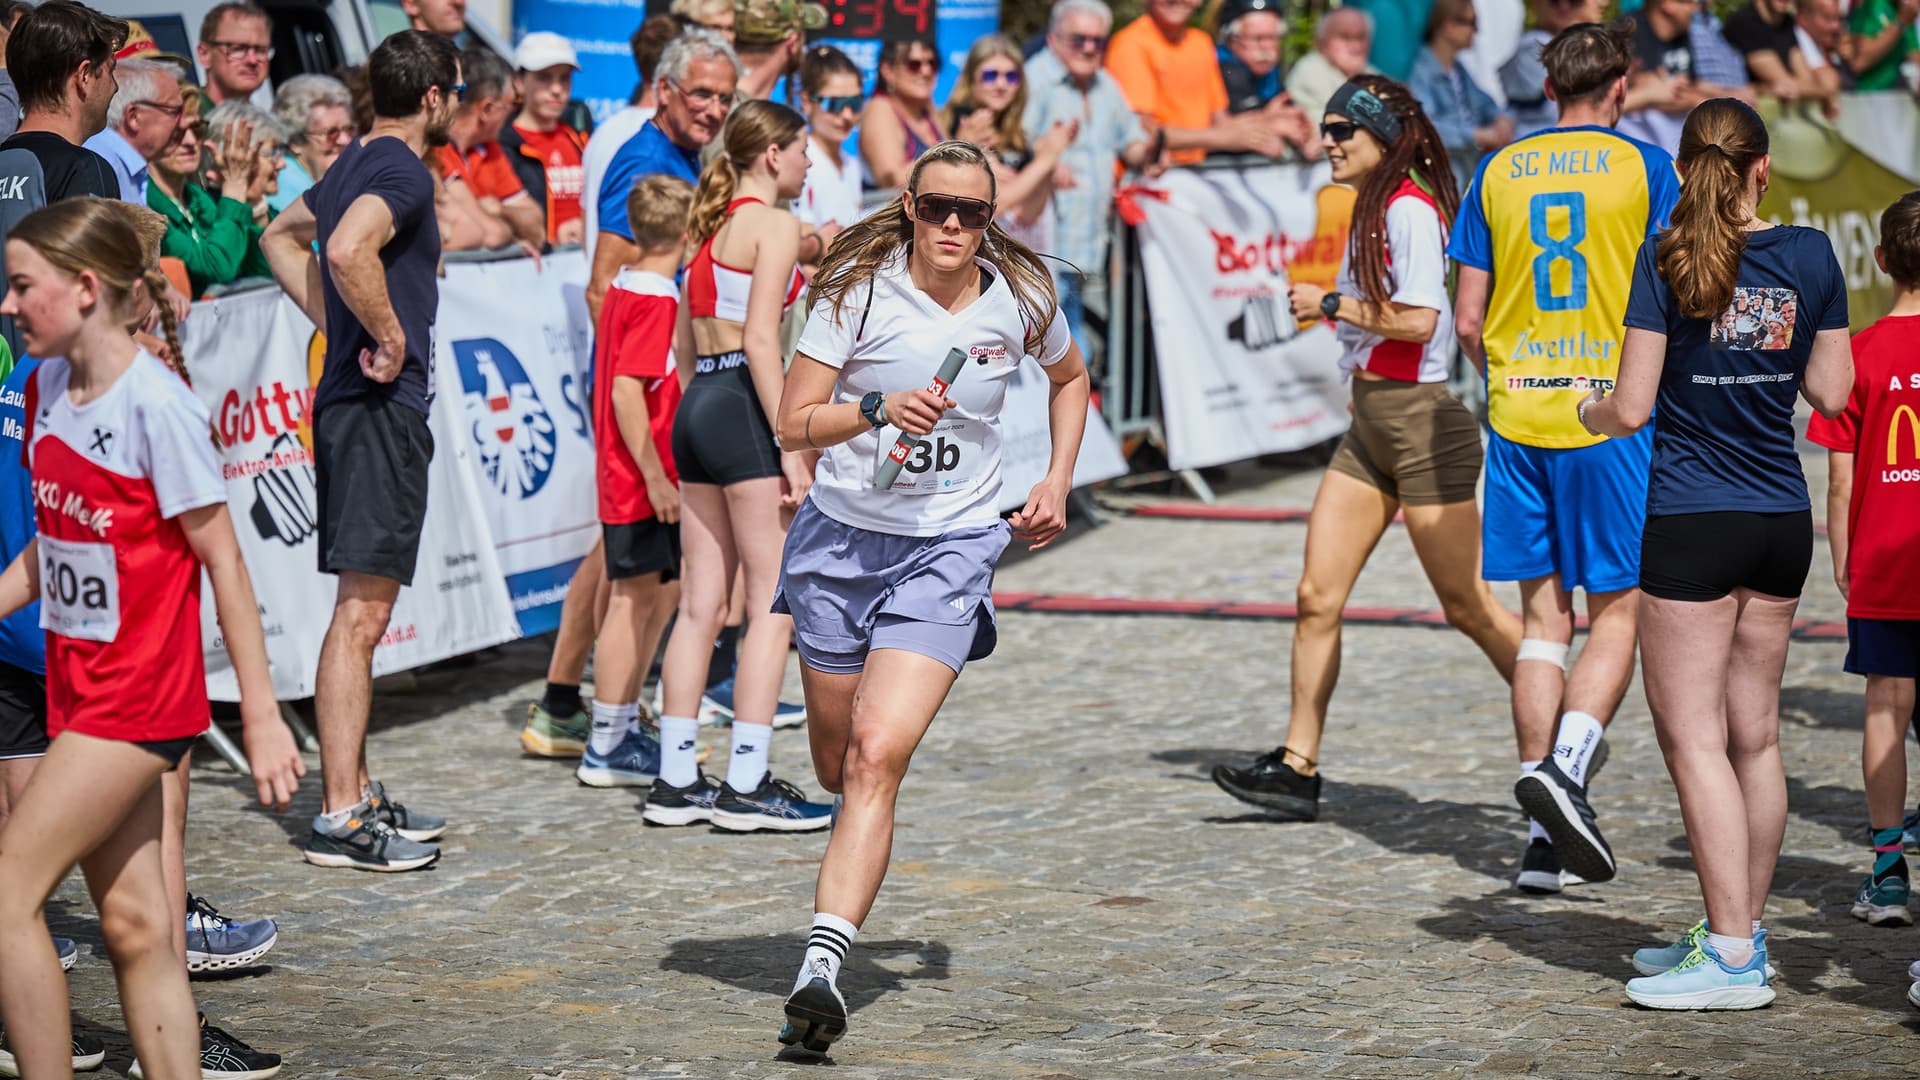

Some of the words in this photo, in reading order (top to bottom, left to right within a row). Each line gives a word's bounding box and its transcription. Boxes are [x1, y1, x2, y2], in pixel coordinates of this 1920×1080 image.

[1510, 151, 1540, 179] SC
[1548, 149, 1611, 175] MELK
[1530, 191, 1587, 312] 8
[1512, 330, 1617, 360] Zwettler
[718, 352, 748, 370] NIK
[0, 384, 25, 408] Lau
[1889, 375, 1902, 391] A
[2, 417, 25, 441] Ma
[62, 491, 114, 537] Melk
[45, 557, 108, 609] 30a
